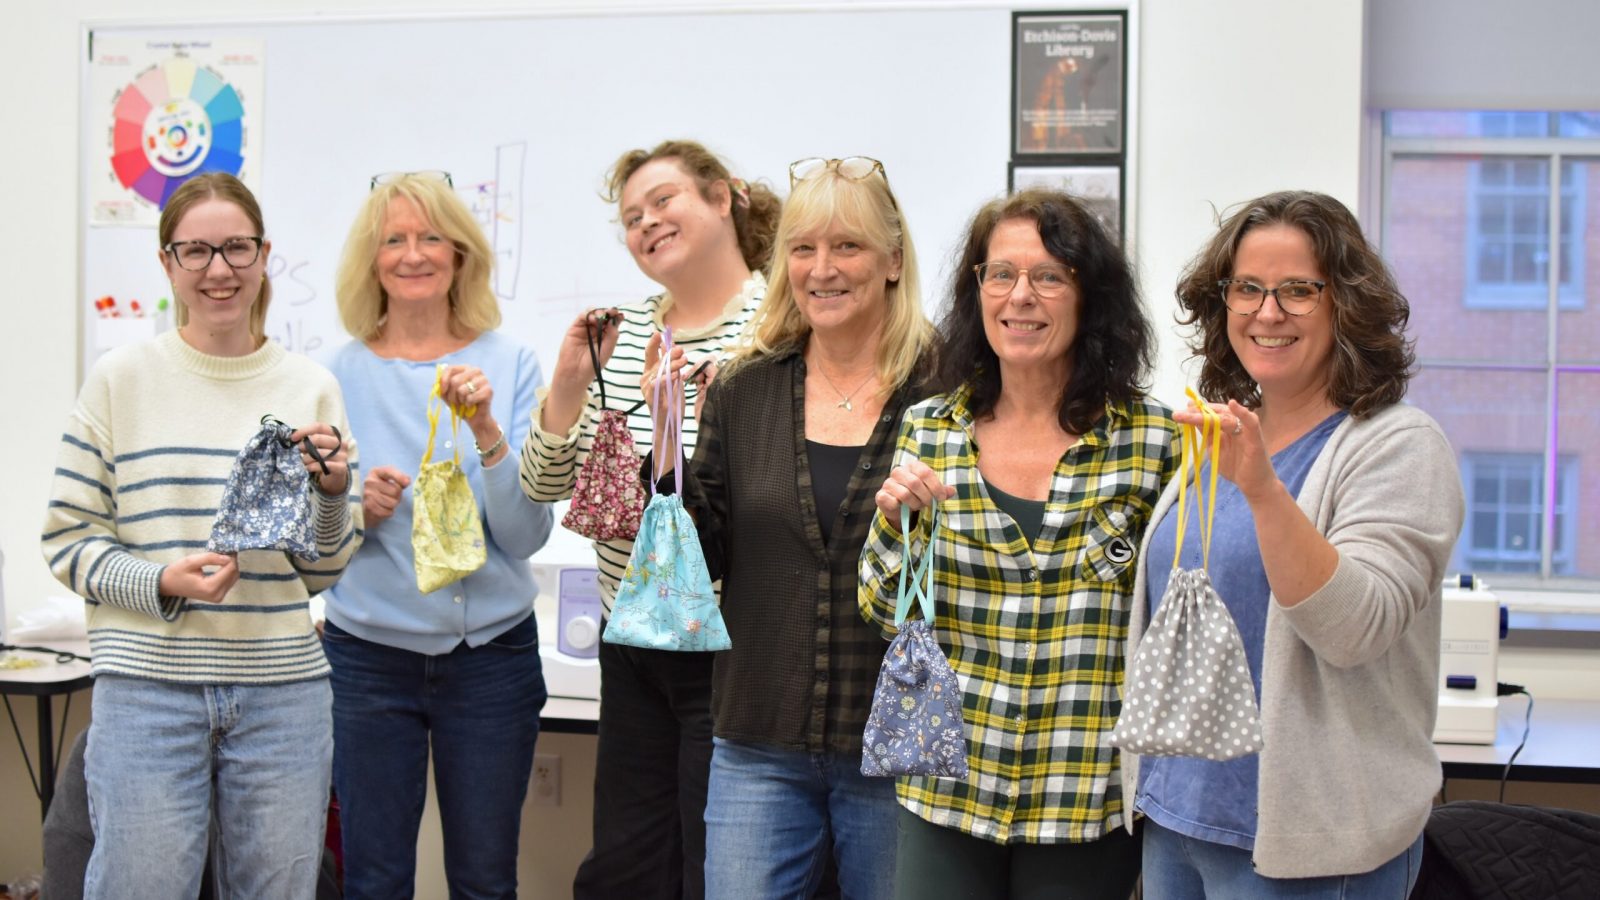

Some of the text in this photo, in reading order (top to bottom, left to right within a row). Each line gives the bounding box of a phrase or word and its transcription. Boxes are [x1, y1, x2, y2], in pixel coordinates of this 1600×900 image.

[1023, 29, 1117, 43] Etchison-Davis
[1045, 44, 1094, 59] Library
[1103, 535, 1134, 564] G
